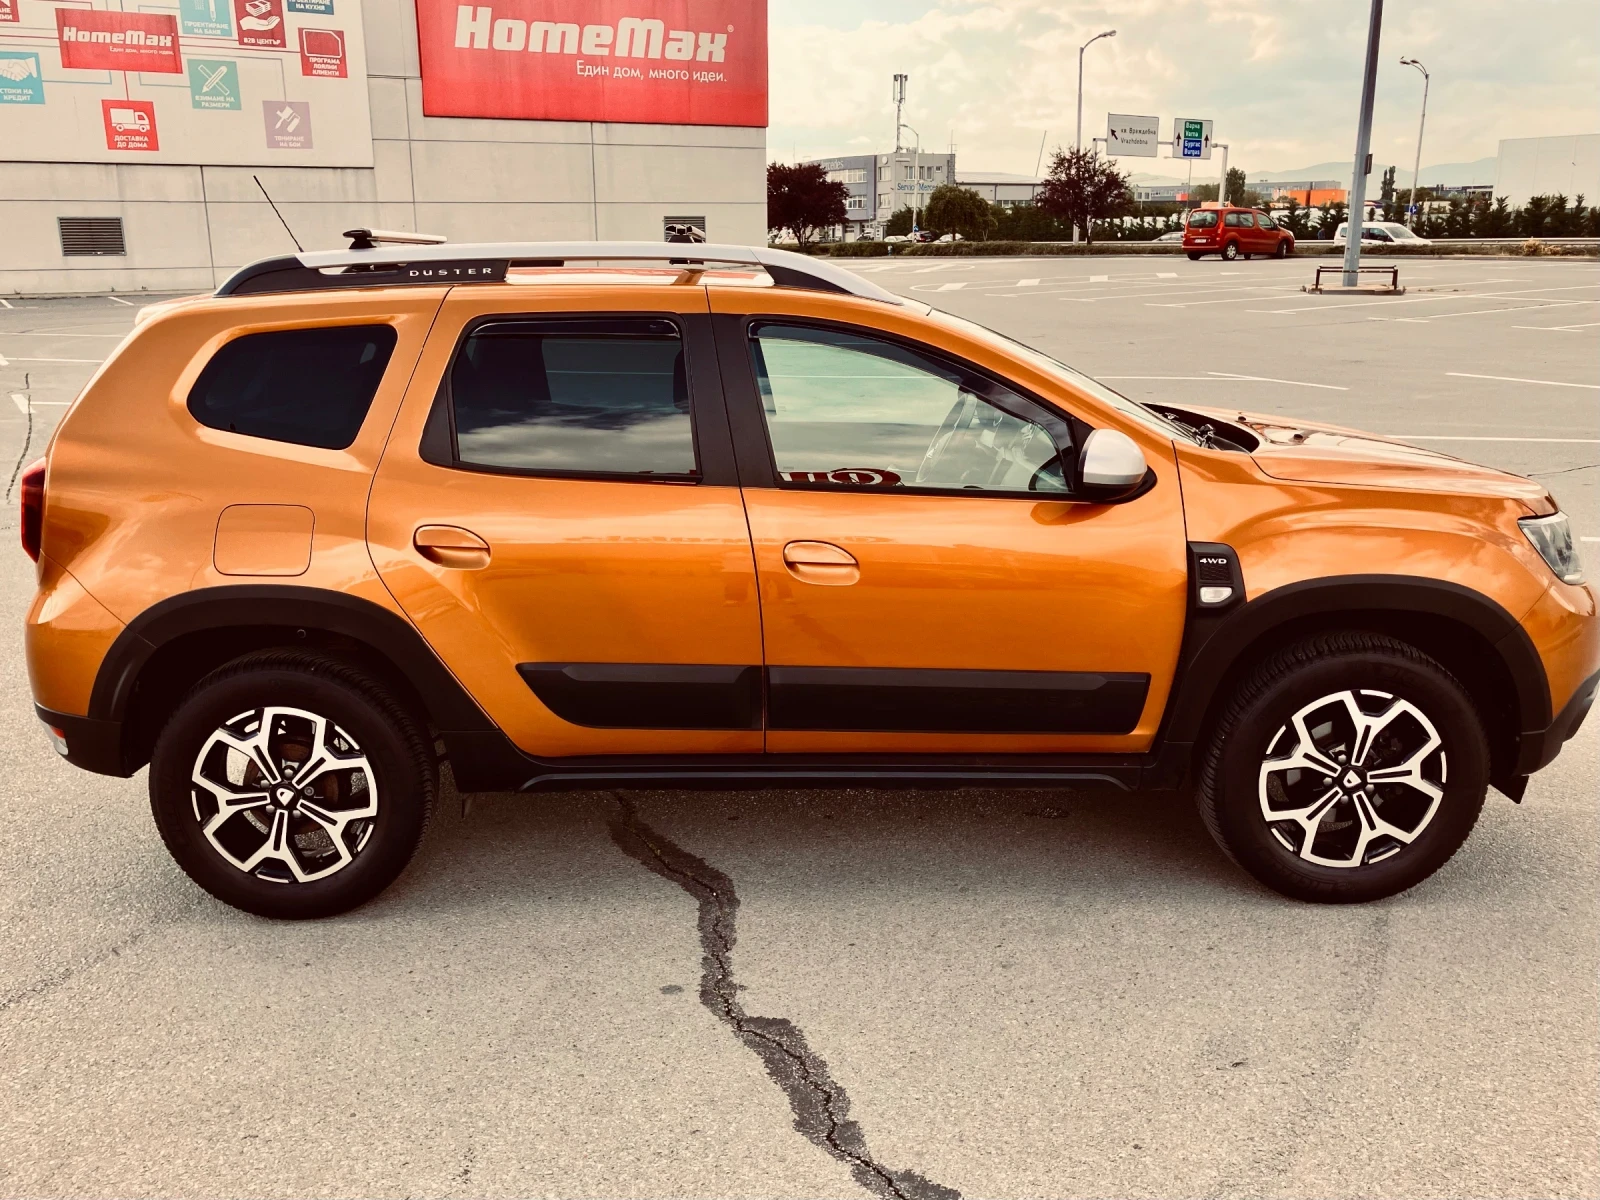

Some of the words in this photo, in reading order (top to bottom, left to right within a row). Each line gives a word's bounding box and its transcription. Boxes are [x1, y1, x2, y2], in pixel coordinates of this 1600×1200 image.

[184, 21, 229, 29] ПРОЕКТИРАНЕ
[63, 26, 173, 47] HomeMax
[455, 5, 728, 63] HomeMax
[576, 59, 610, 77] Един
[613, 66, 645, 81] дом,
[648, 69, 690, 81] много
[692, 70, 728, 83] идеи.
[3, 94, 31, 102] КРЕДИТ
[1184, 140, 1201, 149] Бургас
[1184, 148, 1200, 156] Burgas
[409, 267, 492, 277] DUSTER
